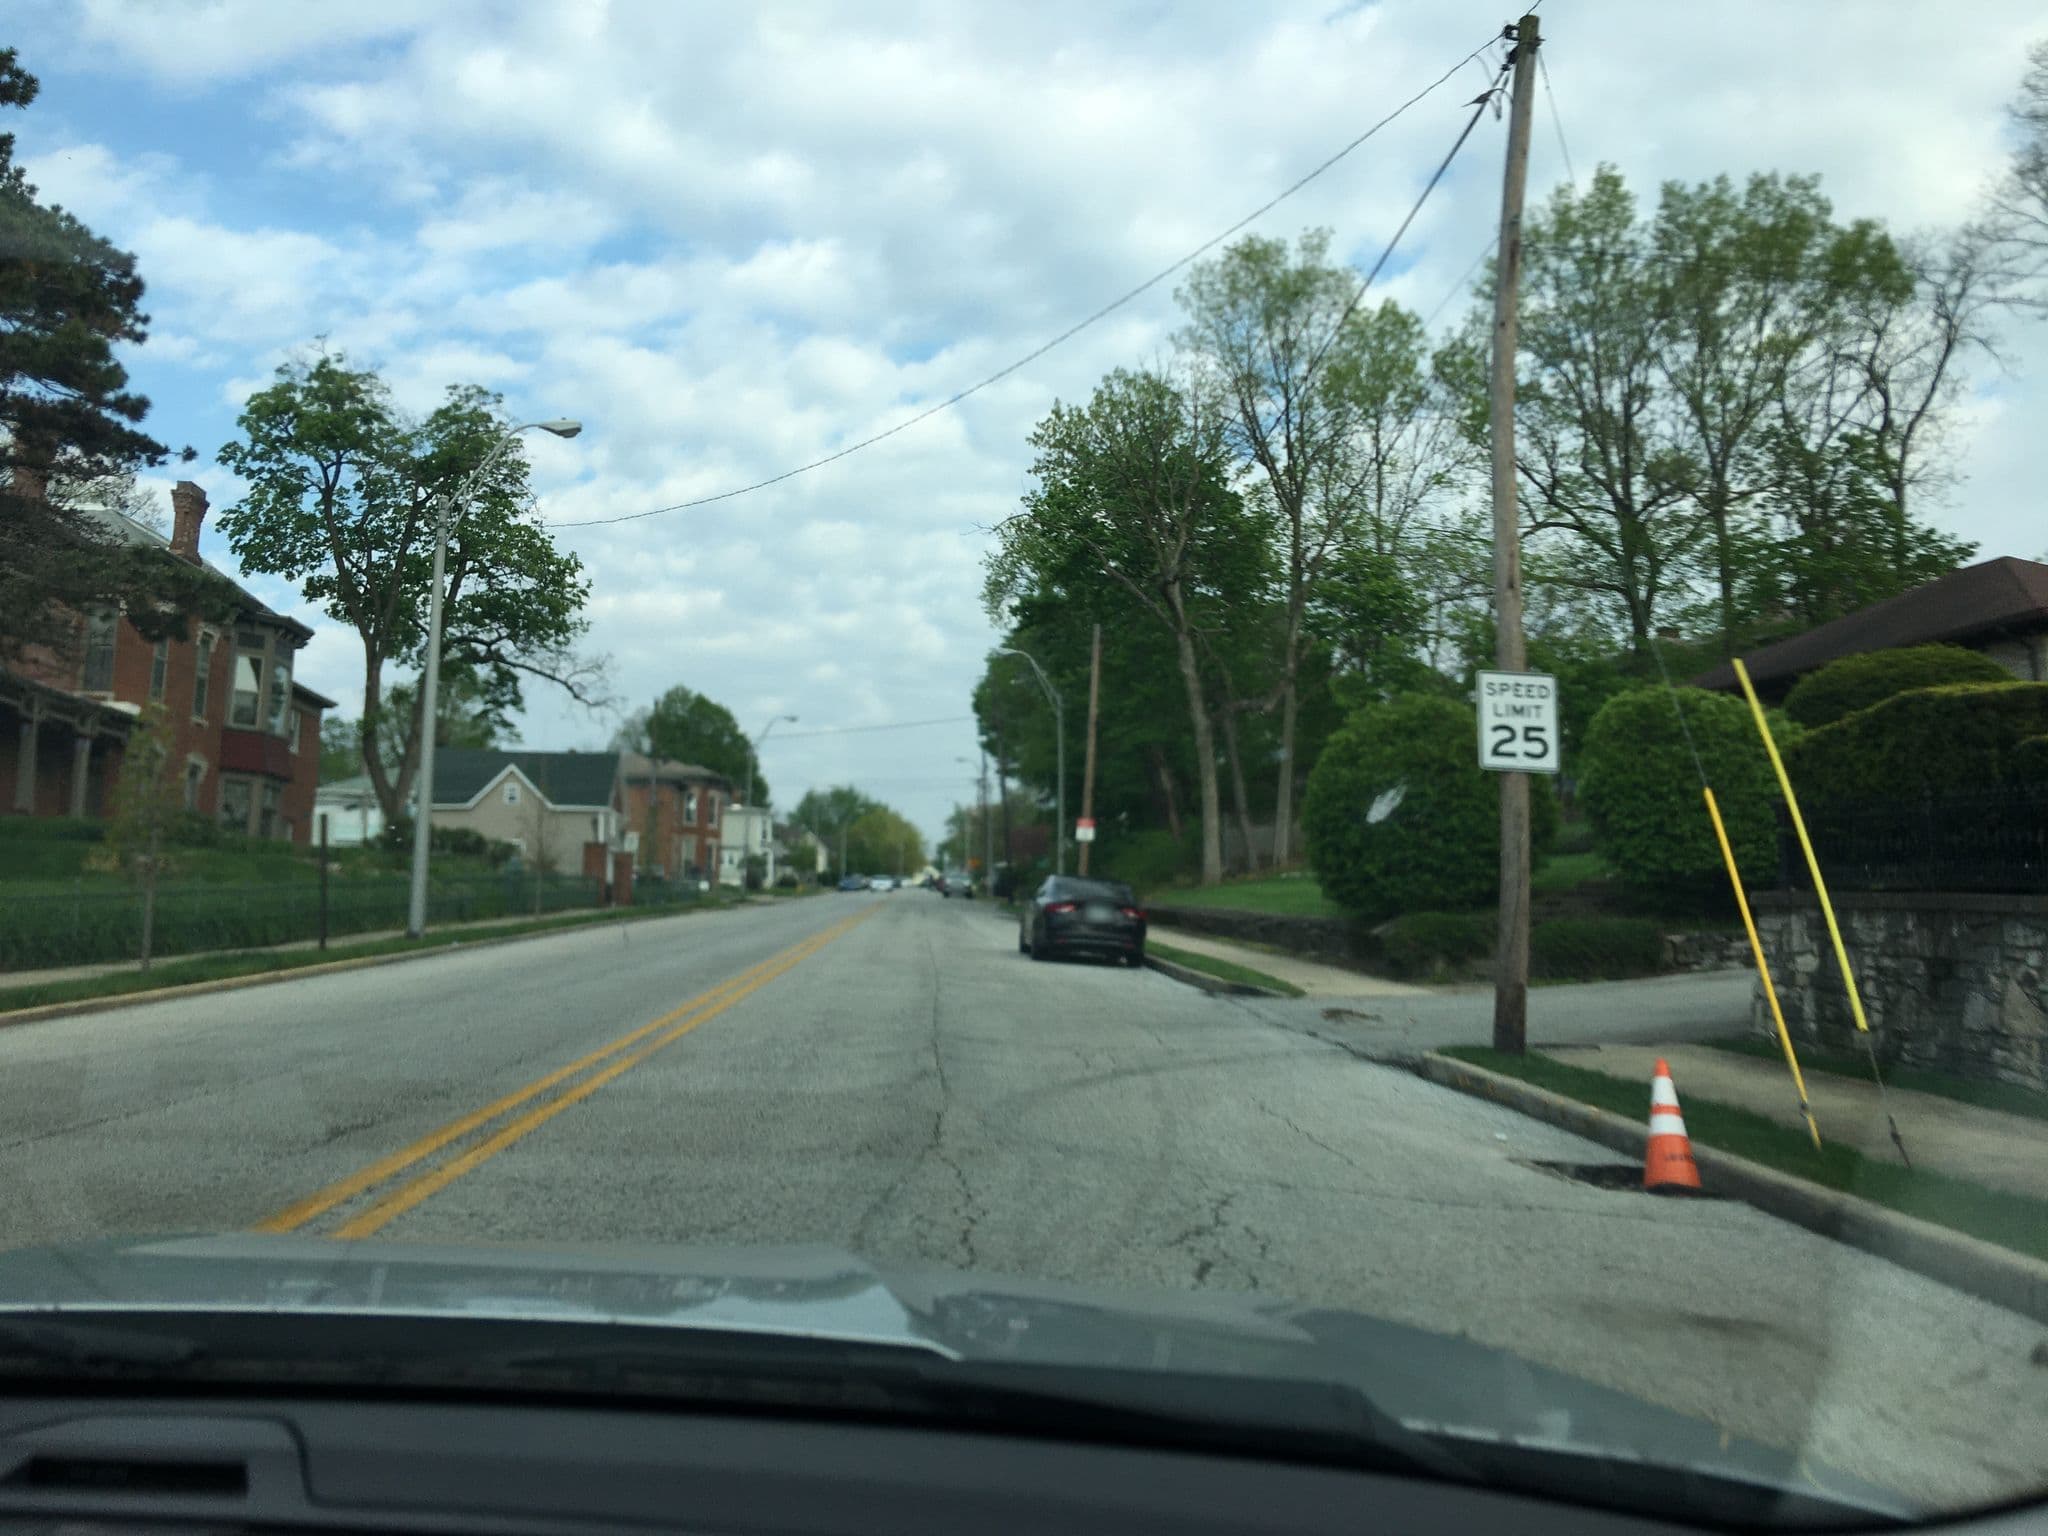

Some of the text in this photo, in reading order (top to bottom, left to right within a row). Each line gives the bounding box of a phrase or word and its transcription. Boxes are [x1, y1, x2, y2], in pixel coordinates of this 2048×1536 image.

[1486, 682, 1551, 699] SPEED
[1492, 703, 1544, 718] LIMIT
[1490, 724, 1549, 759] 25
